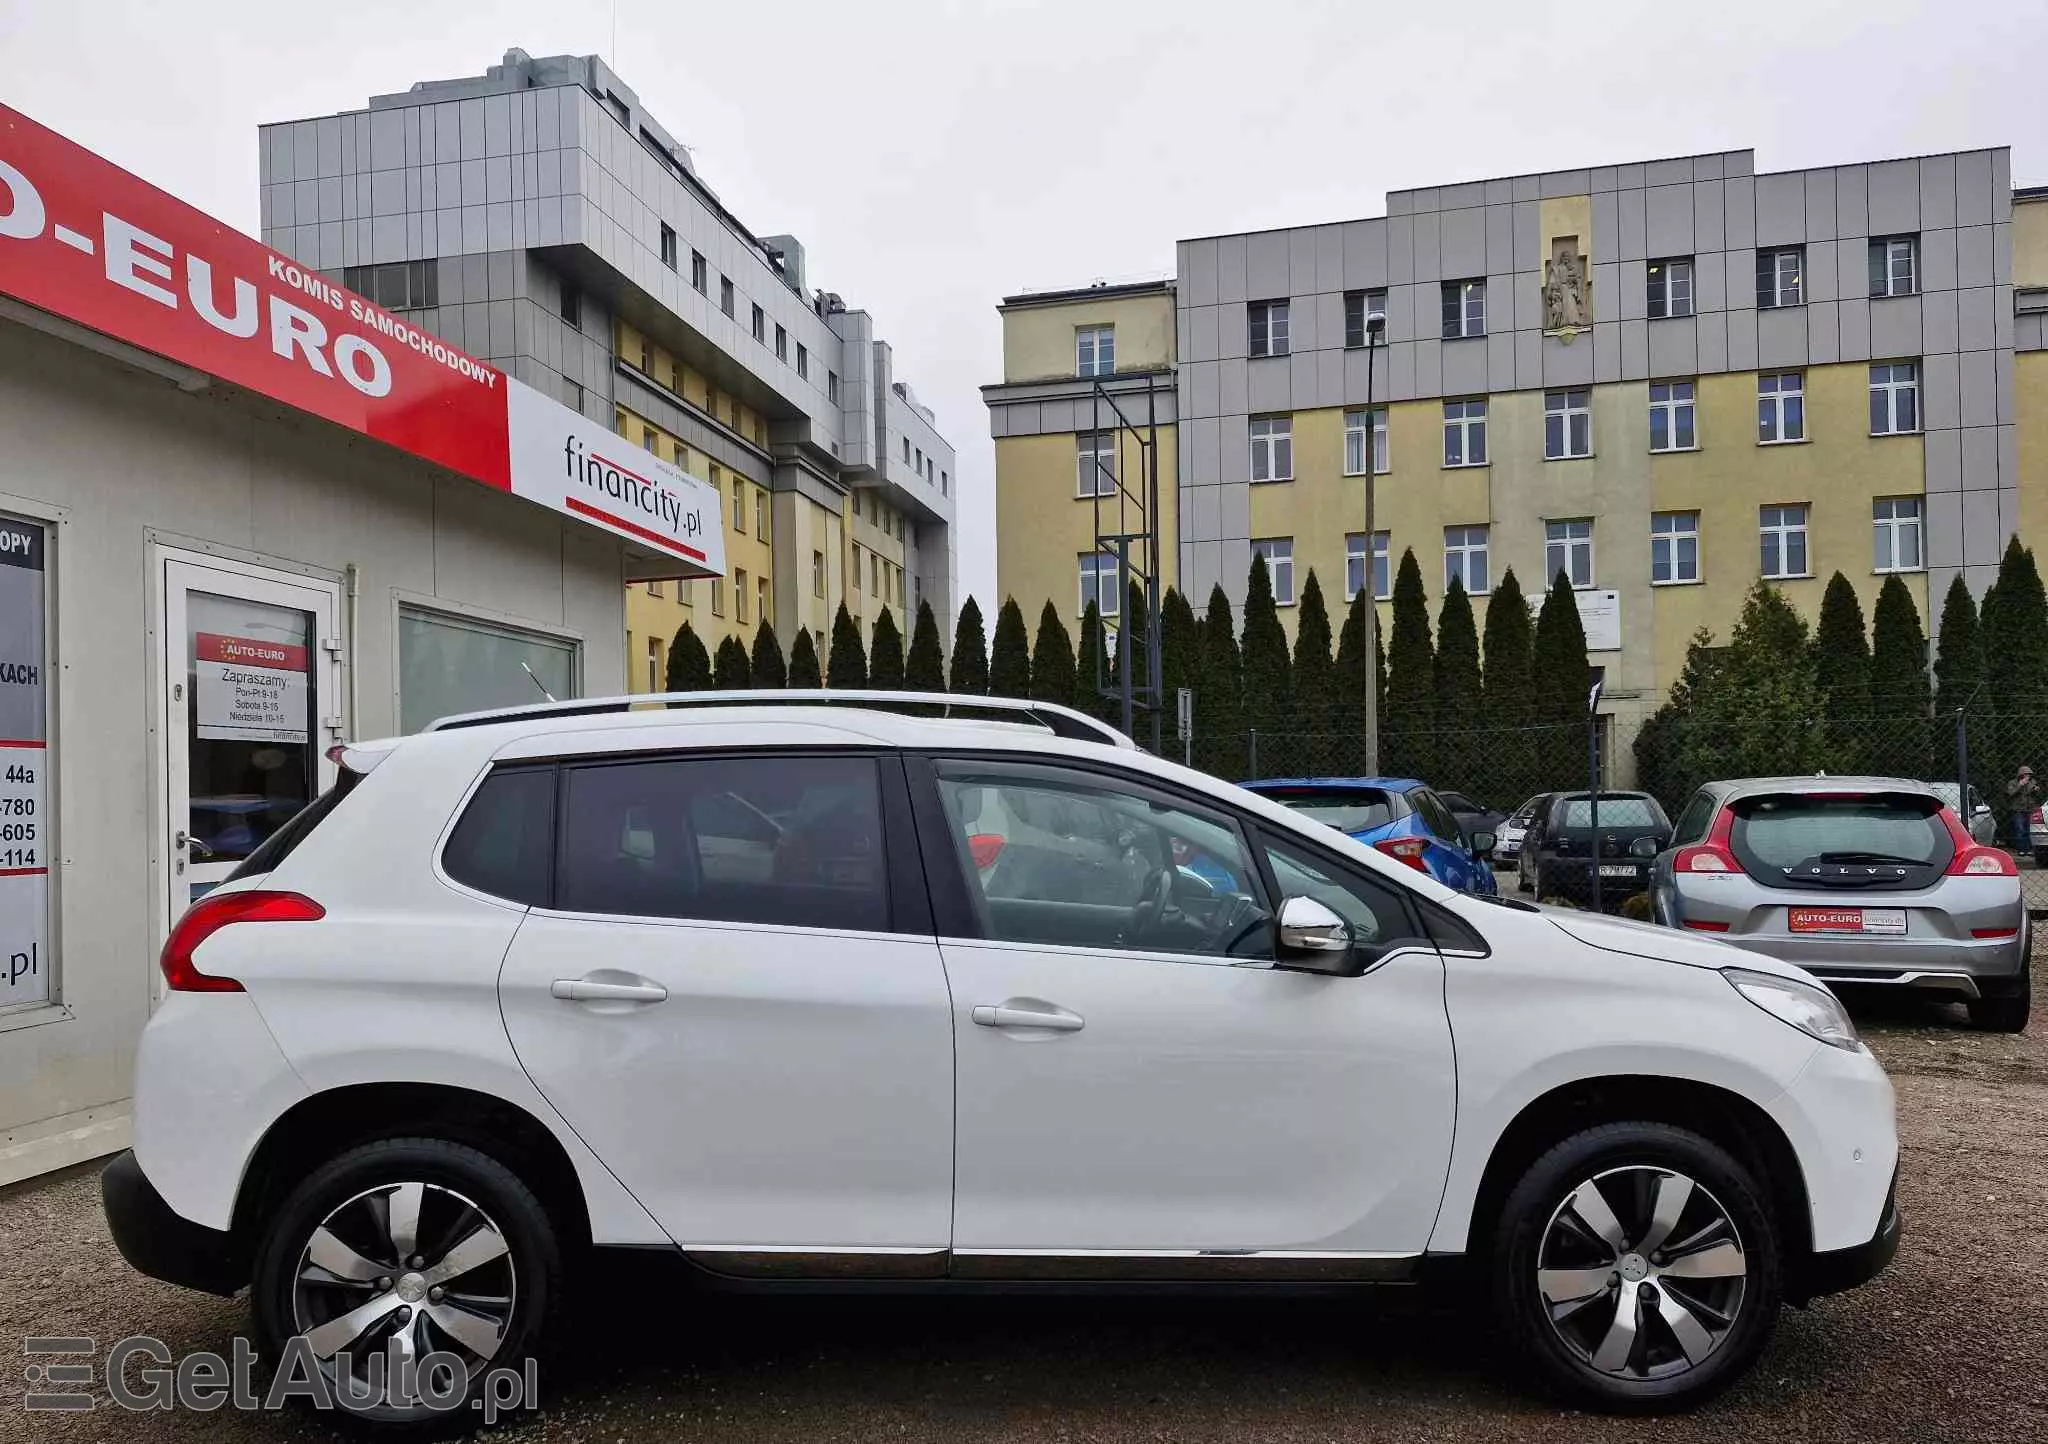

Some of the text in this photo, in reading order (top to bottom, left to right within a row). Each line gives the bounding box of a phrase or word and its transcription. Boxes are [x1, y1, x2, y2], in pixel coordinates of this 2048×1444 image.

[269, 255, 497, 389] KOMIS SAMOCHODOWY
[564, 434, 702, 538] financity.pl
[227, 645, 285, 660] AUTO-EURO
[6, 765, 35, 784] 44a
[1782, 867, 1906, 875] VOLVO
[1797, 914, 1861, 923] AUTO-EURO
